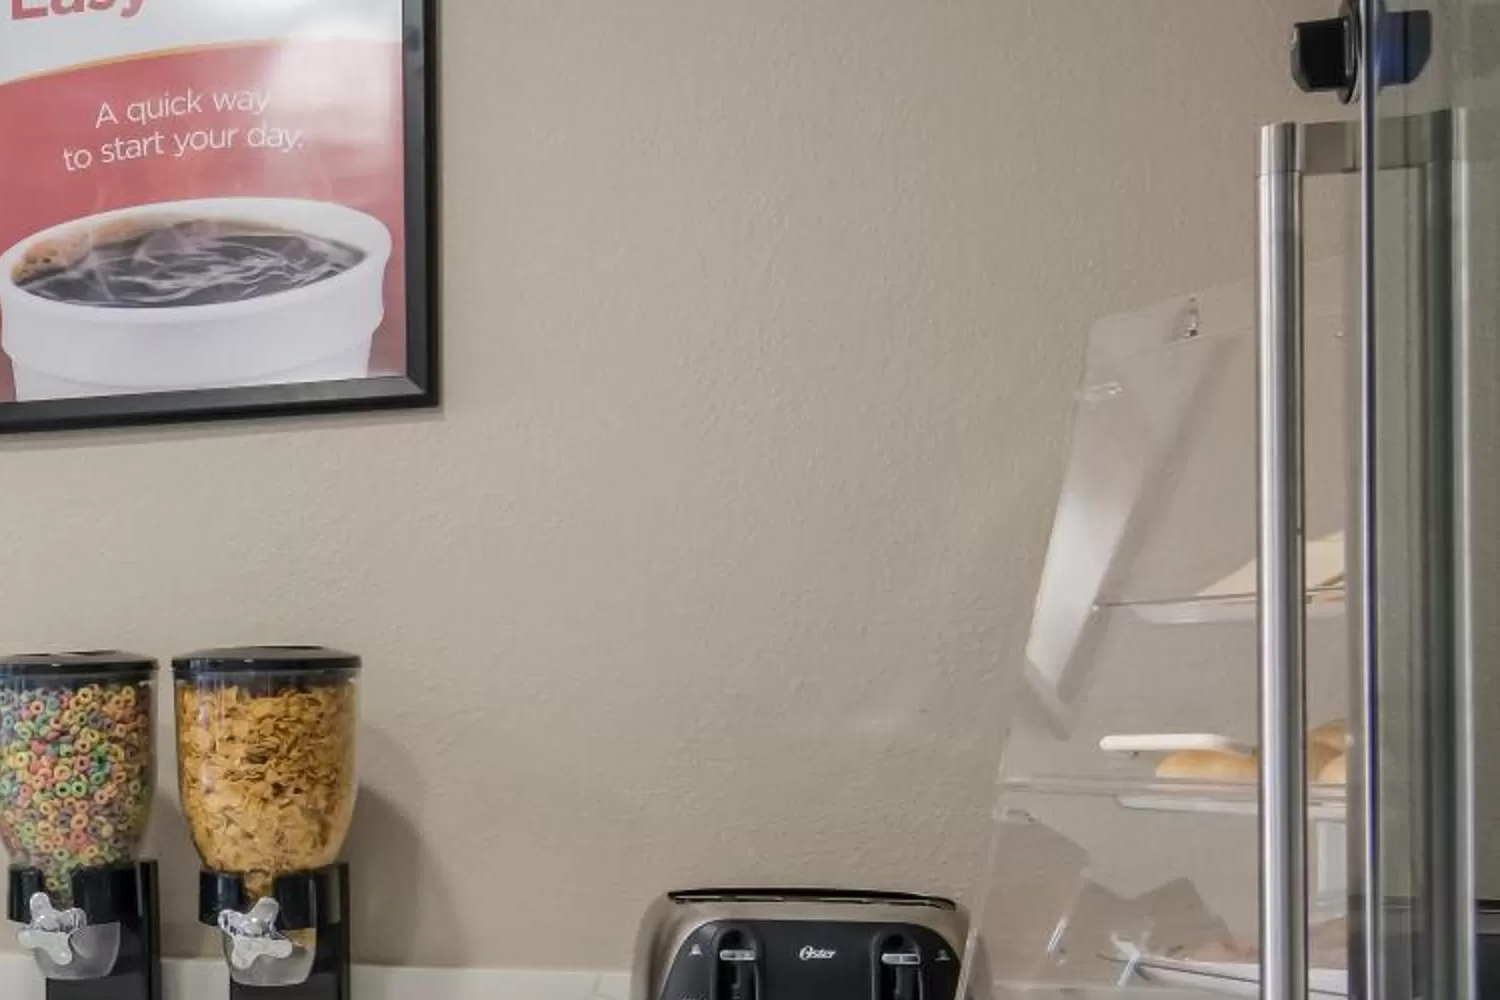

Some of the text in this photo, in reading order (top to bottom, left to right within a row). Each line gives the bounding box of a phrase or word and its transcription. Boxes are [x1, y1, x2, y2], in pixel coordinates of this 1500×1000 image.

[95, 88, 271, 128] A quick way
[63, 119, 303, 171] to start your day.
